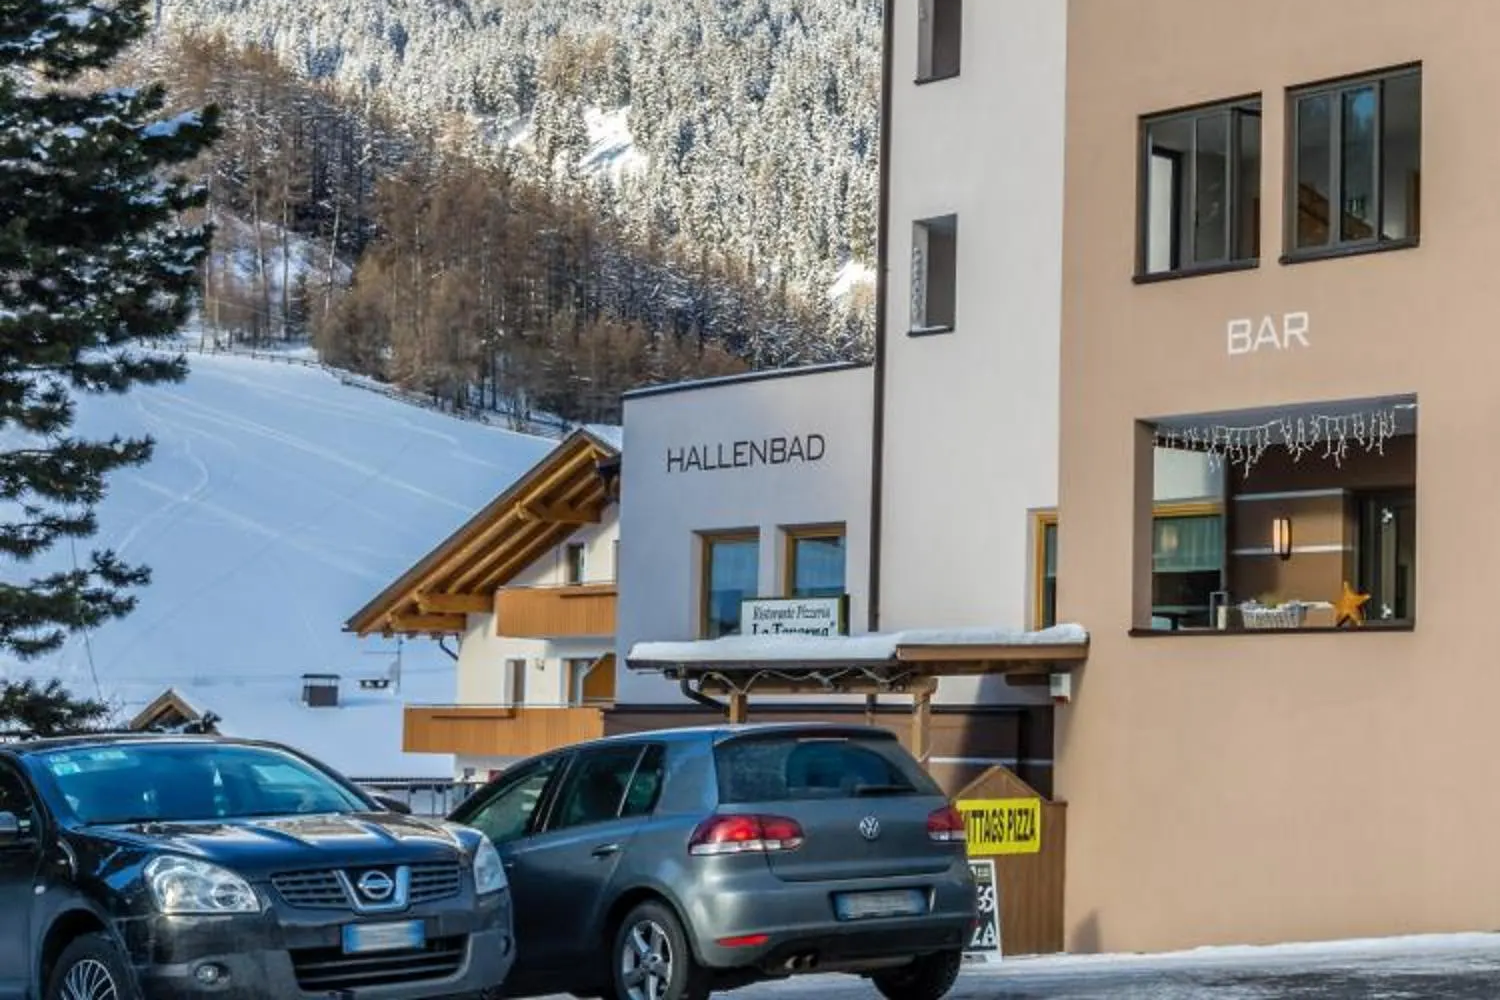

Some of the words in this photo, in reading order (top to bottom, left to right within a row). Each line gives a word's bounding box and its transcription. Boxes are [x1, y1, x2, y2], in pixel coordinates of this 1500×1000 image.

[1226, 311, 1312, 355] BAR
[667, 434, 826, 473] HALLENBAD
[1007, 807, 1037, 842] PIZZA
